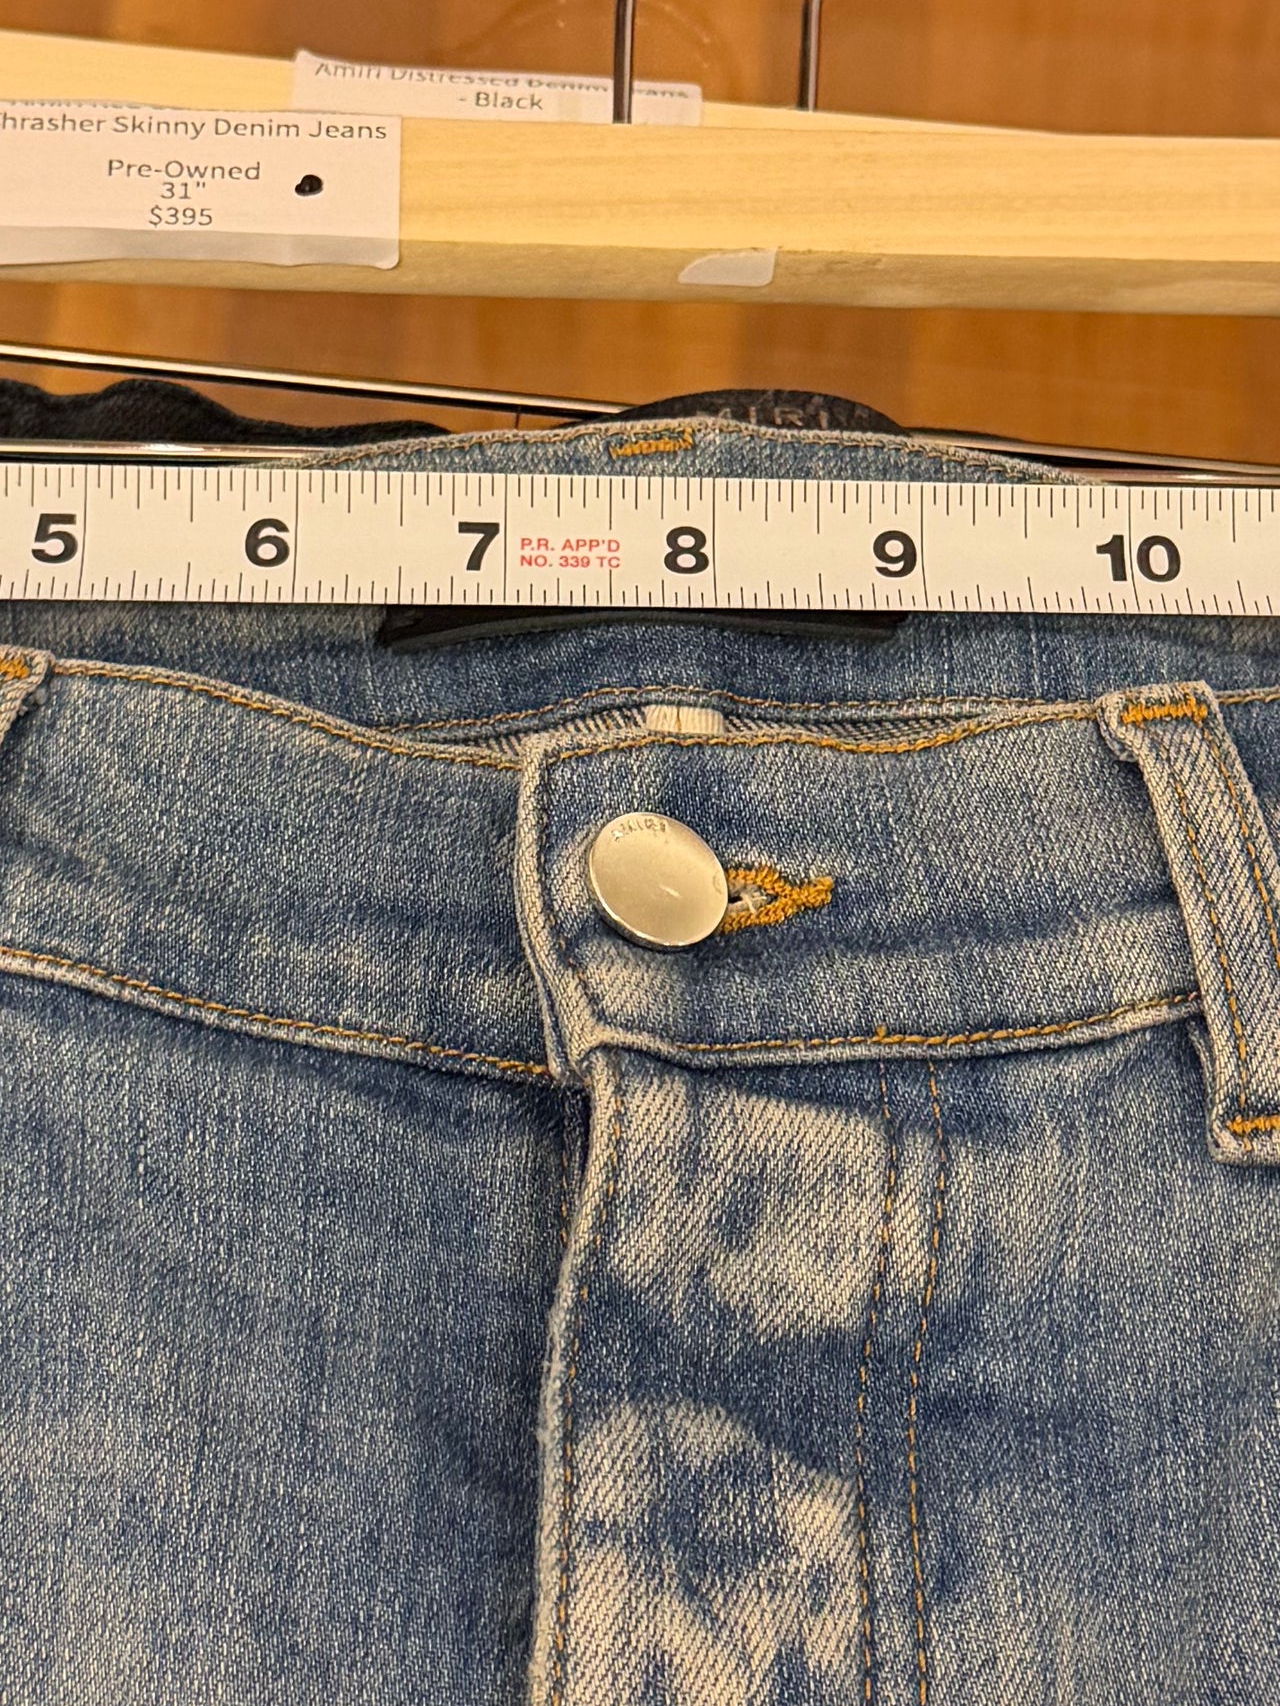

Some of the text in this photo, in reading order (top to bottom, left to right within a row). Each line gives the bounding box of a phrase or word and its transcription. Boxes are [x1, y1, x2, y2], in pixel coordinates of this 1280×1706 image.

[474, 90, 545, 112] Black
[112, 115, 206, 141] Skinny
[214, 117, 300, 139] Denim
[308, 118, 388, 141] Jeans
[107, 158, 261, 181] Pre-Owned
[160, 181, 207, 201] 31"
[148, 204, 214, 228] $395
[30, 513, 78, 563] 5
[244, 517, 290, 568] 6
[457, 522, 500, 571] 7
[663, 525, 710, 575] 8
[872, 529, 918, 579] 9
[1095, 534, 1181, 583] 10
[520, 537, 621, 553] P.R. APP'D
[520, 555, 621, 569] NO. 339 TC
